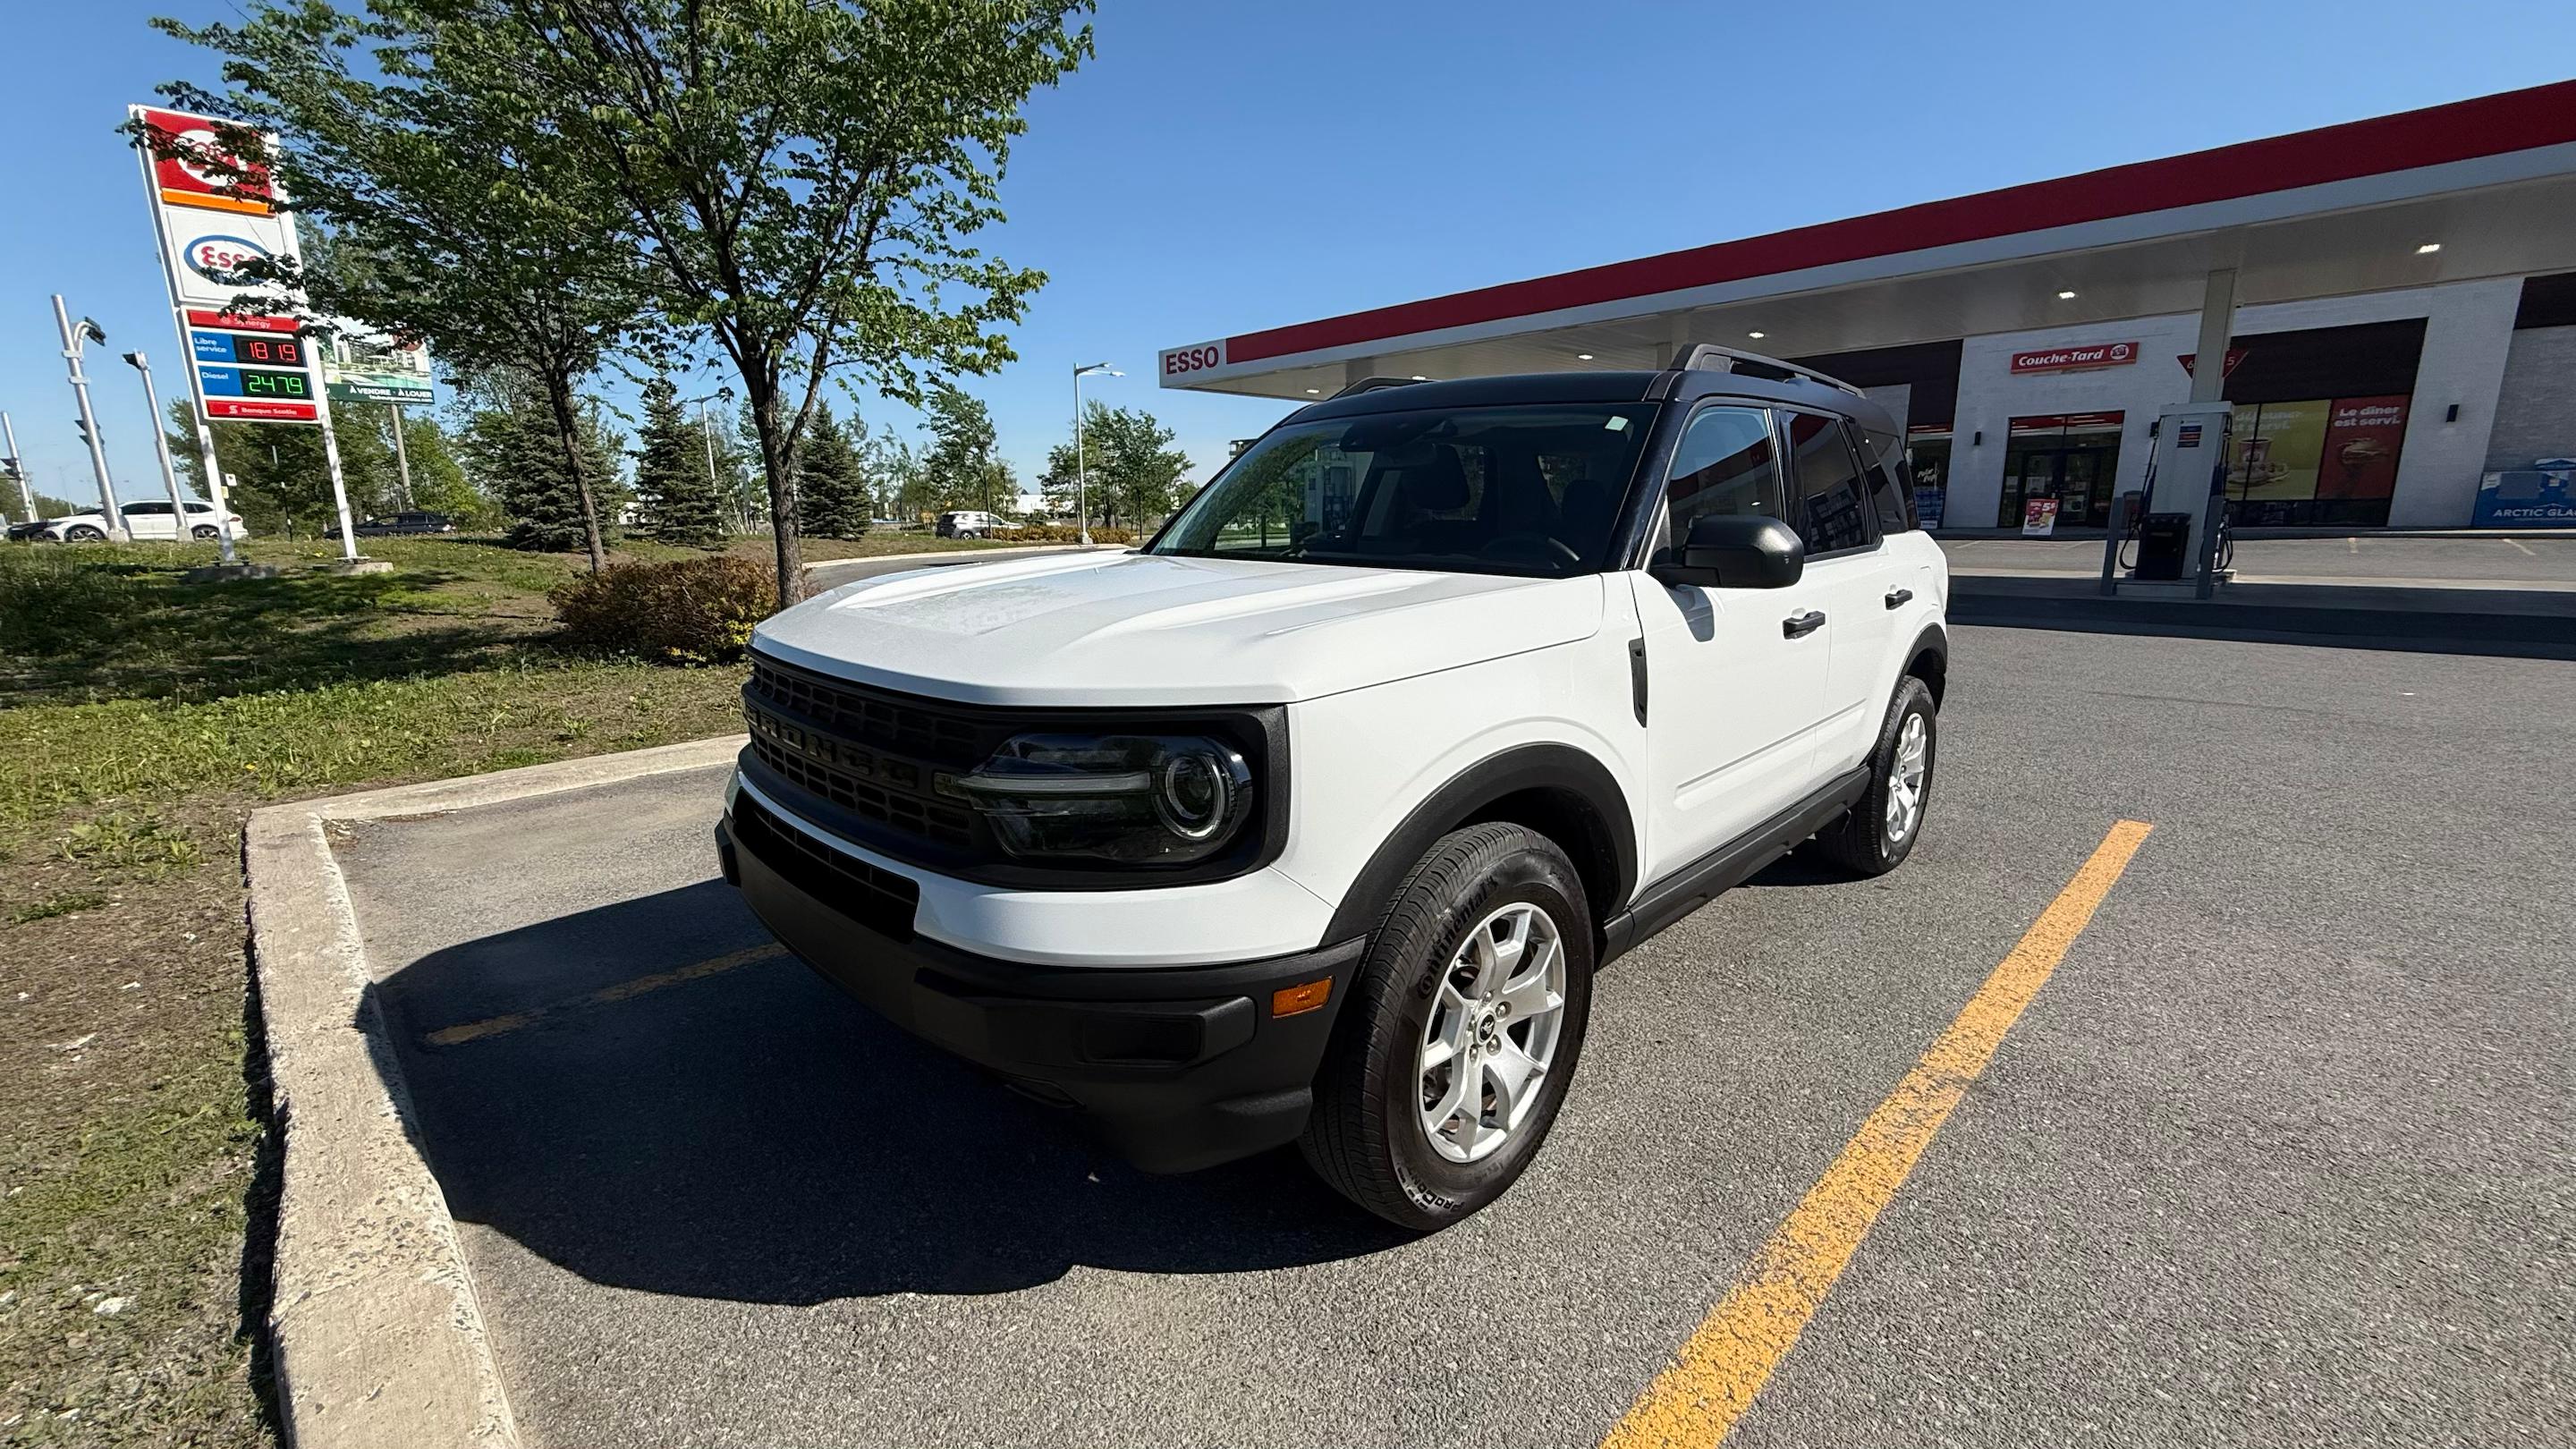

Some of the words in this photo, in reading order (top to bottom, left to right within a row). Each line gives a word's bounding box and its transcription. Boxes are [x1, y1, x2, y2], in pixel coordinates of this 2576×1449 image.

[194, 337, 217, 345] Libre
[196, 344, 227, 353] service
[1165, 346, 1219, 375] ESSO
[2018, 349, 2104, 367] Couche-Tard
[2227, 357, 2235, 366] 5
[201, 371, 229, 380] Diesel
[357, 387, 392, 395] VENDRE
[405, 390, 433, 398] LOUER
[241, 407, 272, 415] Banque
[2339, 407, 2359, 417] Le
[2334, 416, 2358, 427] est
[2360, 415, 2401, 426] servi.
[2492, 508, 2544, 517] ARCTIC
[2546, 508, 2576, 517] GLA
[745, 702, 918, 788] BRONCO
